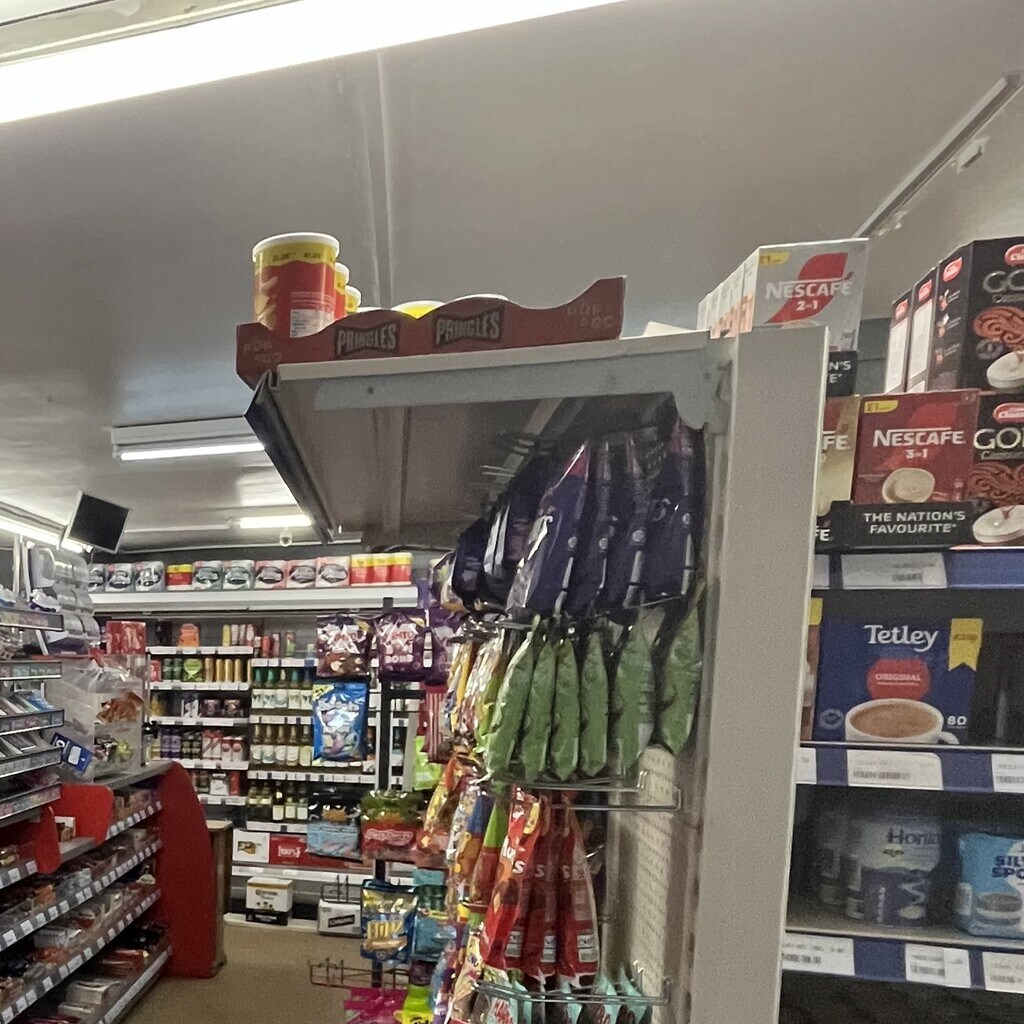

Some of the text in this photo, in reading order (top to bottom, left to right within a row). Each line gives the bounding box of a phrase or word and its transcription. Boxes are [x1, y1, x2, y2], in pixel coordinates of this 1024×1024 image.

[983, 269, 1024, 294] GO
[336, 322, 397, 356] PRINGLES
[434, 309, 502, 342] PRINGLES
[972, 428, 1024, 450] GO
[863, 511, 966, 523] THE NATION'S
[862, 623, 940, 653] Tetley
